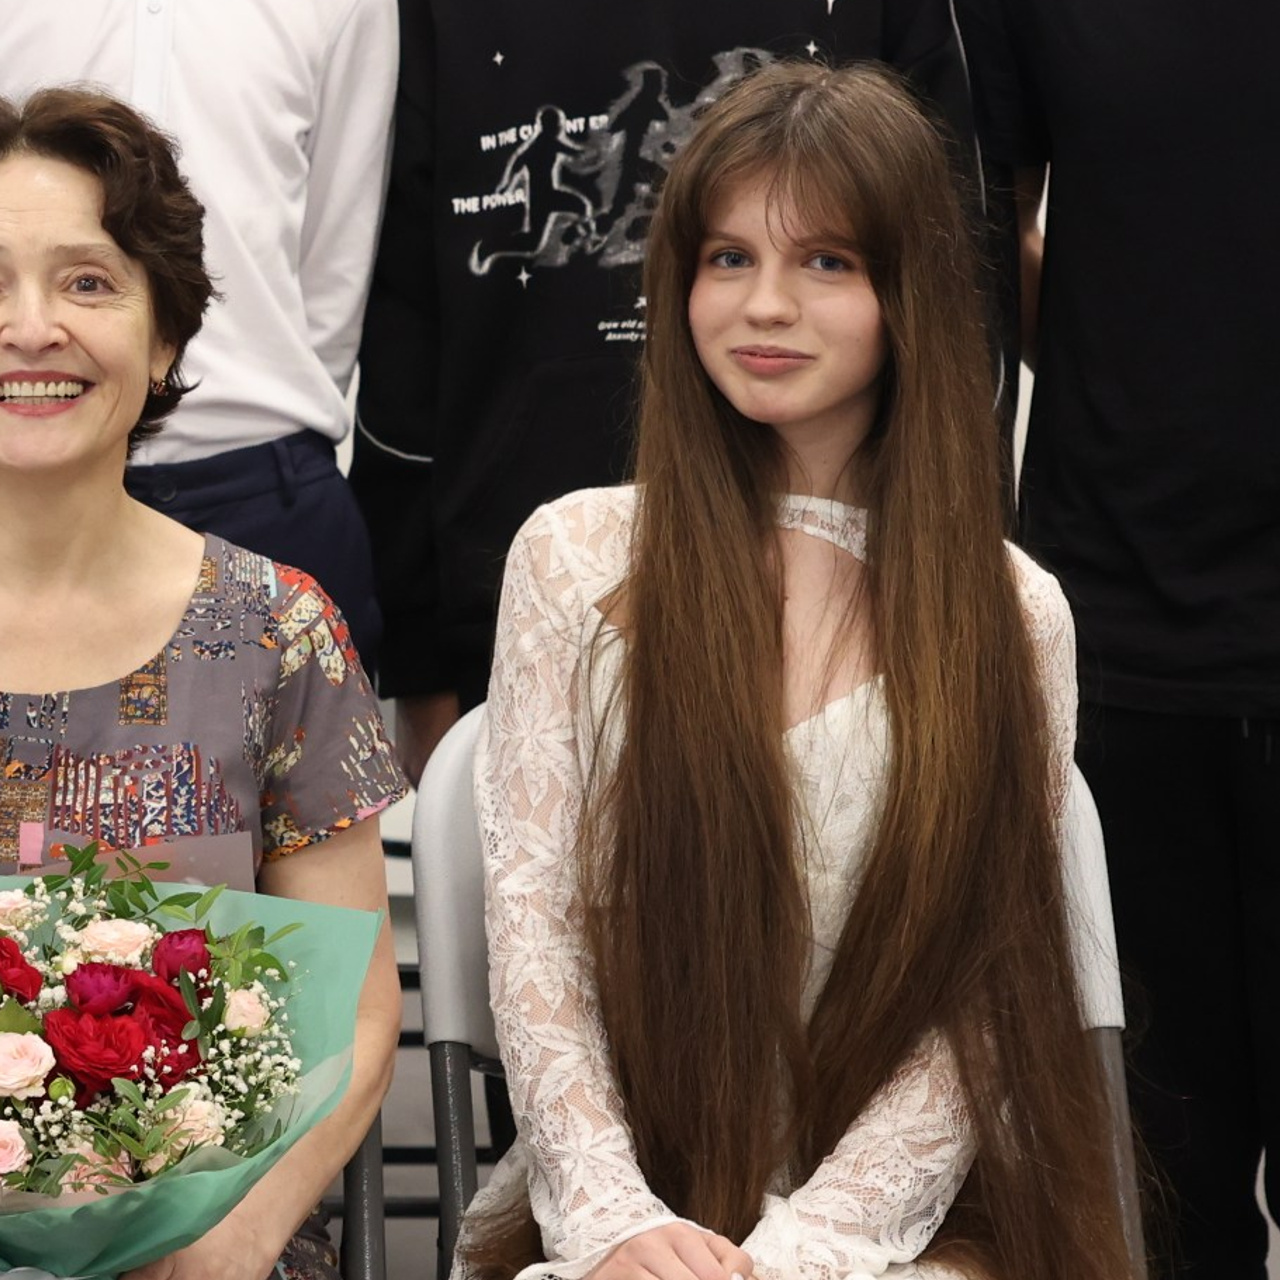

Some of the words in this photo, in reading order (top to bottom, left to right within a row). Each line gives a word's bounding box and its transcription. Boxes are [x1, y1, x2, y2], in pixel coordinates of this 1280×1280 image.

[480, 134, 496, 151] IN
[498, 127, 518, 147] THE
[452, 196, 480, 214] THE
